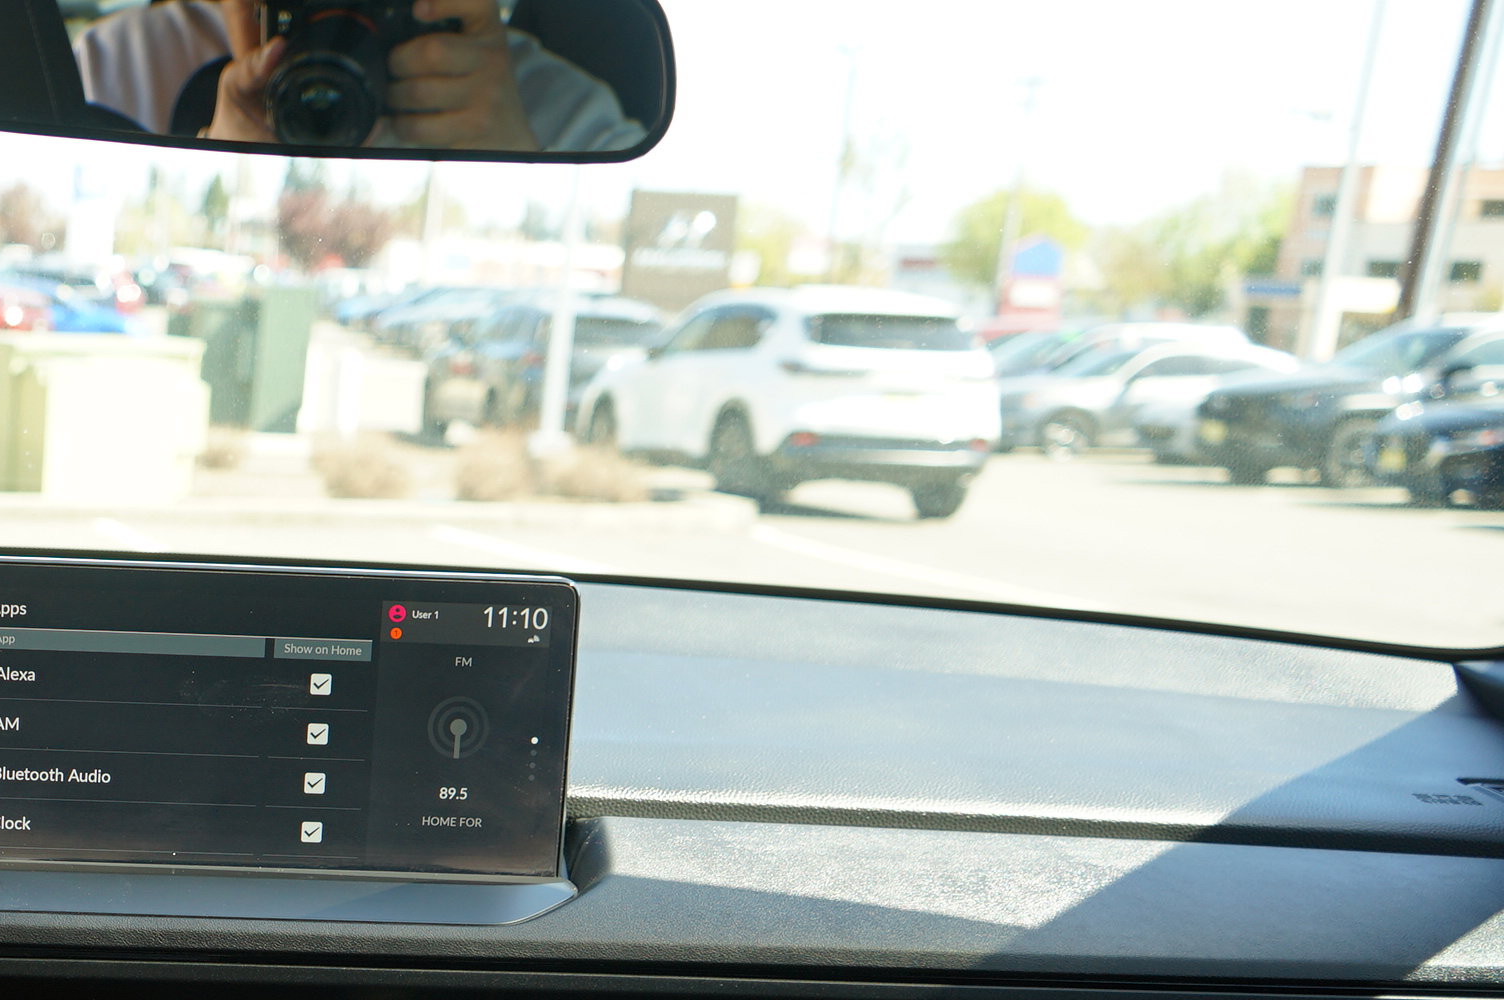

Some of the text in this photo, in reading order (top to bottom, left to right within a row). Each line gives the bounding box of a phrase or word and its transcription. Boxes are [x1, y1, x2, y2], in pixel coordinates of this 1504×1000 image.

[412, 610, 439, 620] User 1
[483, 606, 549, 630] 11:10
[284, 643, 362, 656] Show on Home
[455, 657, 473, 667] FM
[68, 768, 111, 783] Audio
[439, 787, 468, 801] 89.5
[422, 816, 482, 828] HOME FOR
